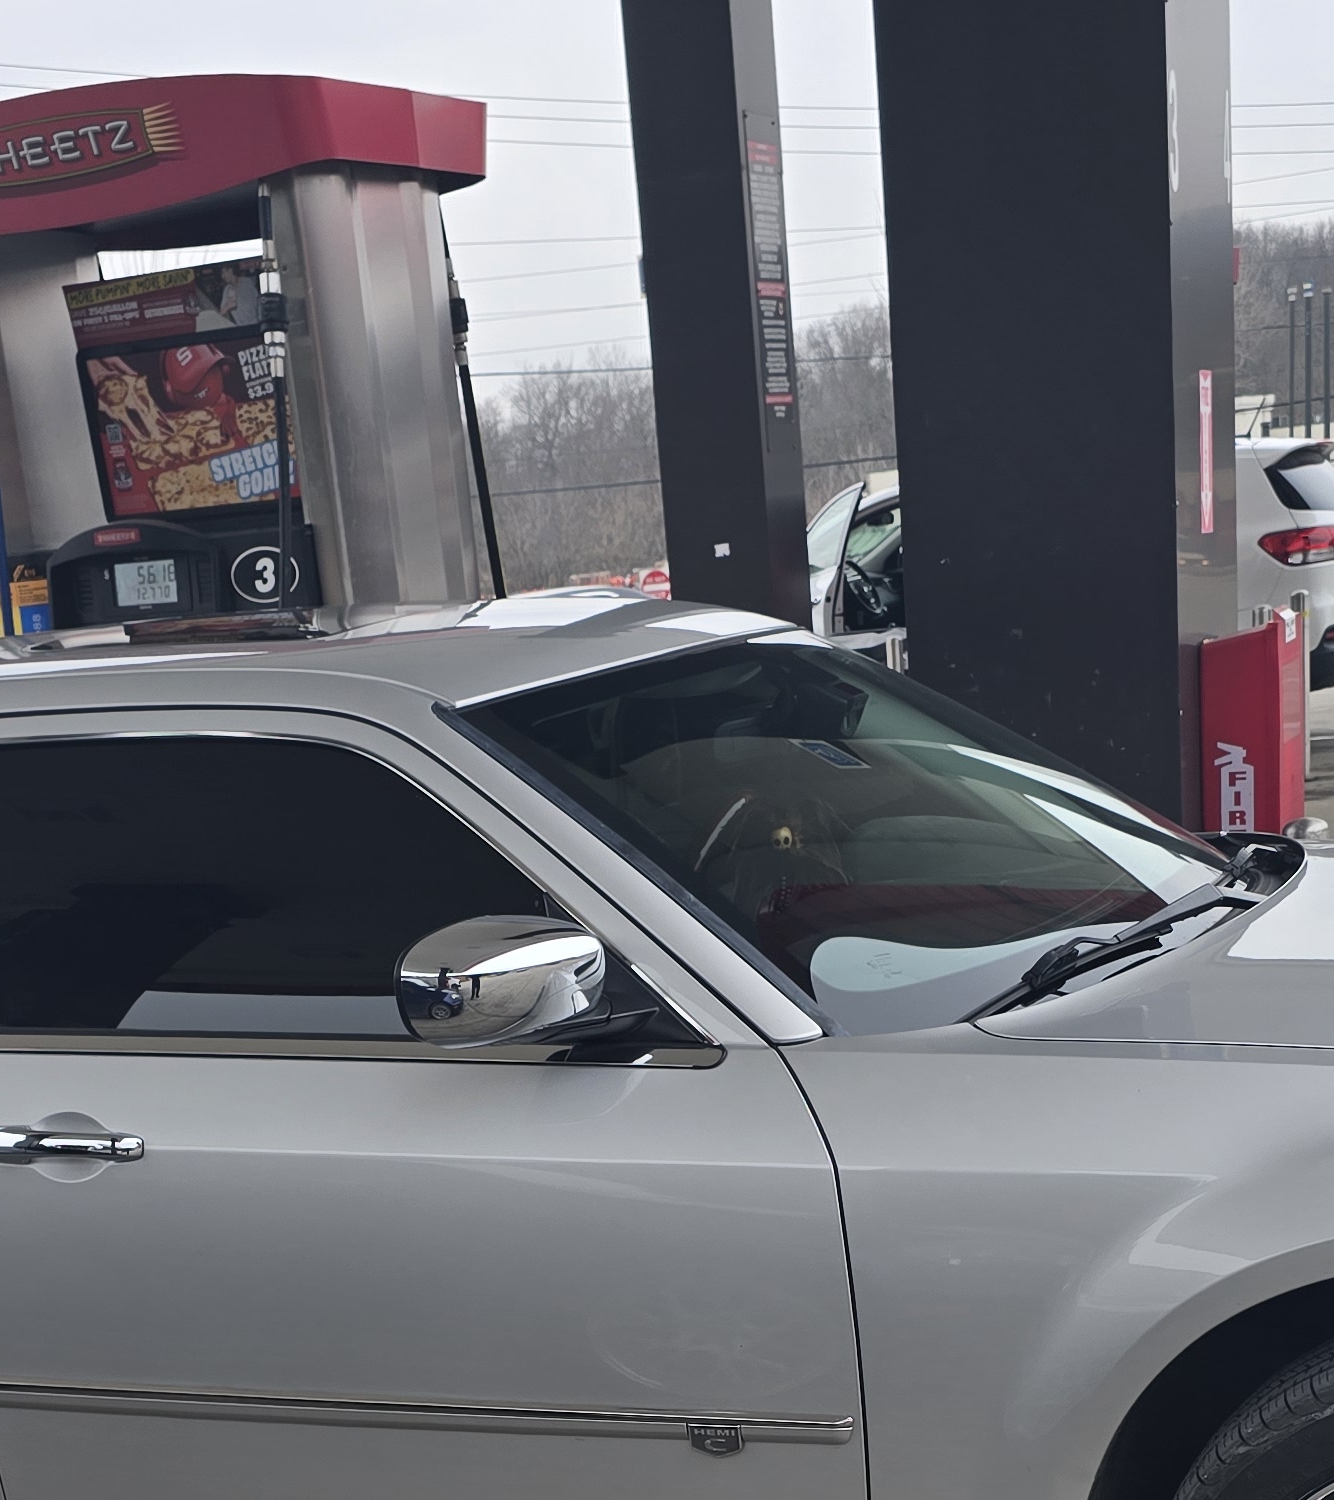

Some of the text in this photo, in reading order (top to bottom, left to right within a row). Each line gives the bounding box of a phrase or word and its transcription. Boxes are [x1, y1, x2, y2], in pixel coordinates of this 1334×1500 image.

[237, 344, 269, 366] PIZZ
[242, 360, 271, 381] FLAT
[248, 382, 274, 399] $3.9
[210, 440, 278, 482] STRETC
[254, 557, 276, 593] 3
[1228, 771, 1247, 832] FIR
[693, 1428, 736, 1437] HEMI
